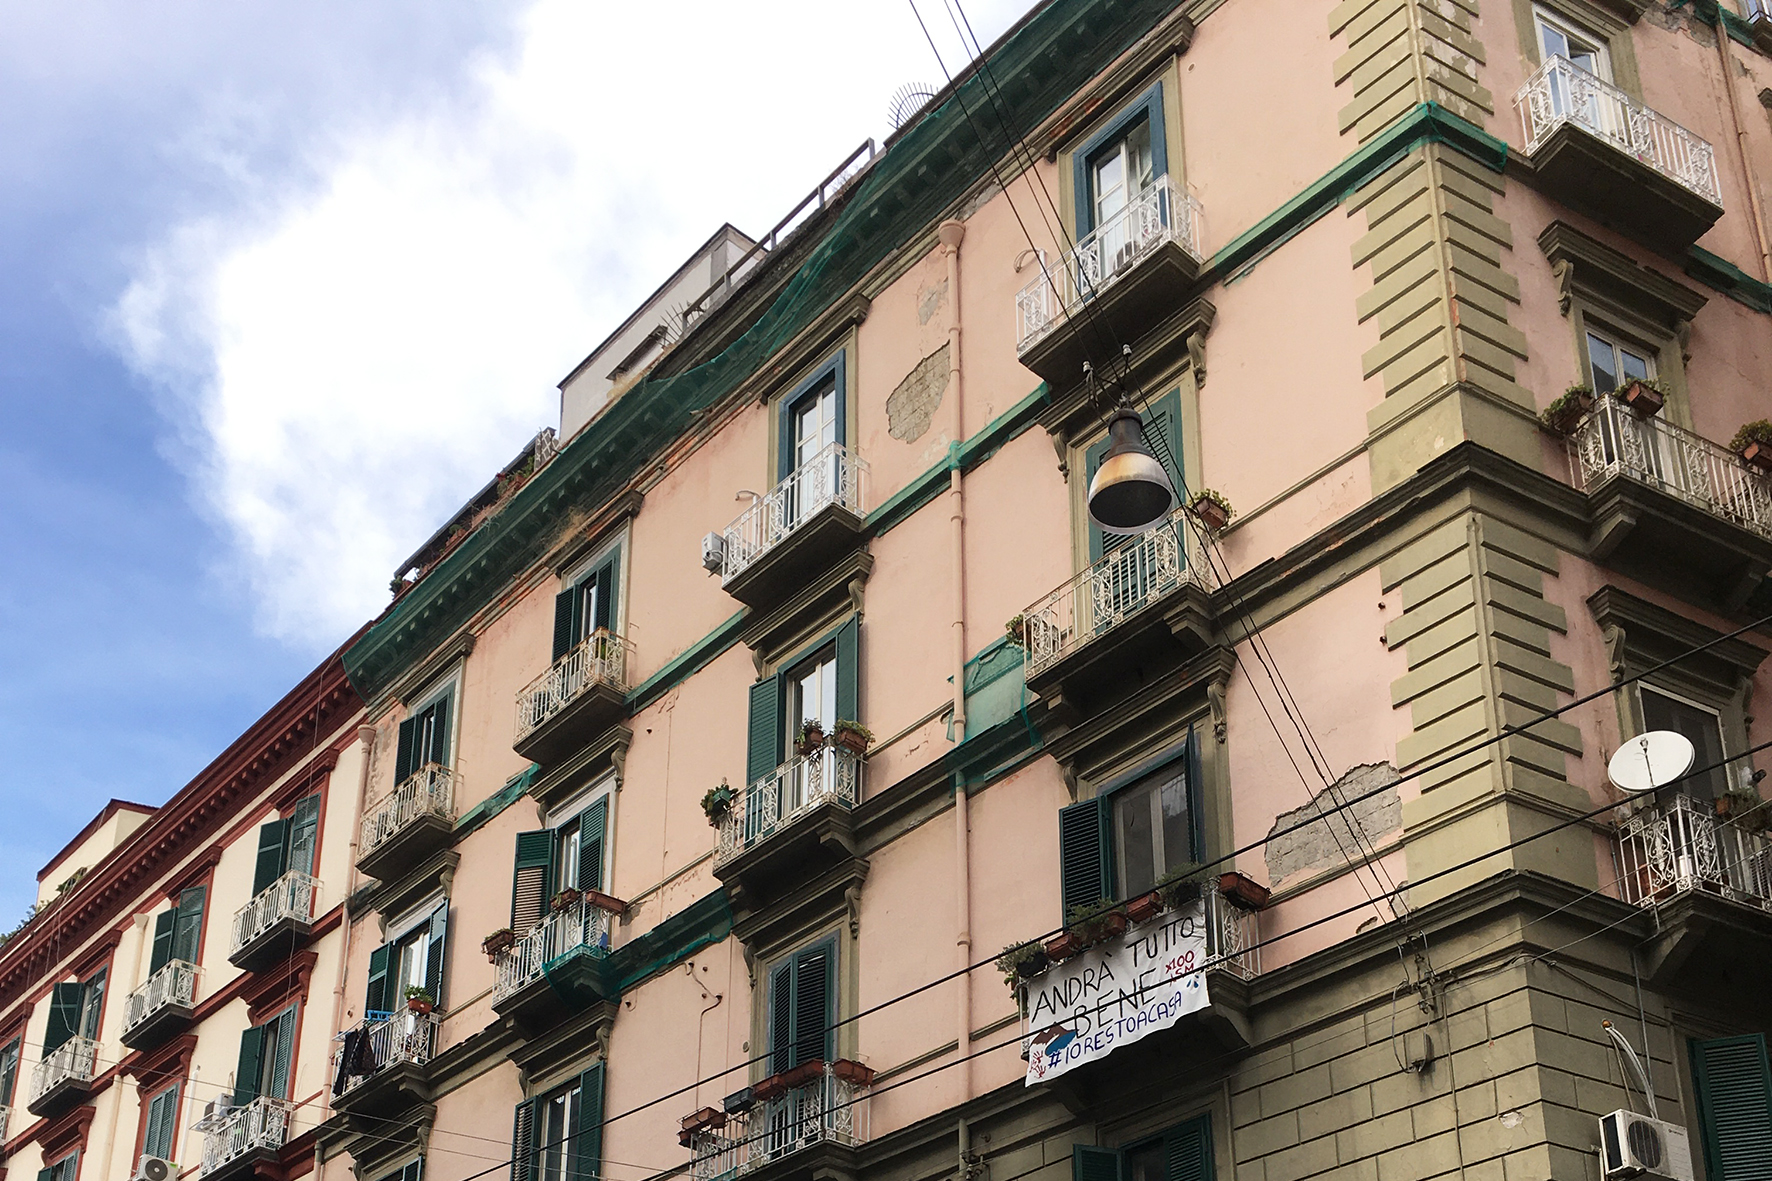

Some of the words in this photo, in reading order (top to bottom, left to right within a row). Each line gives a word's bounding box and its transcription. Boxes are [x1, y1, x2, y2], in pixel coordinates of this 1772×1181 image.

[1031, 952, 1115, 1024] ANDRÀ
[1126, 916, 1195, 968] TUTTO
[1073, 967, 1157, 1039] BENE
